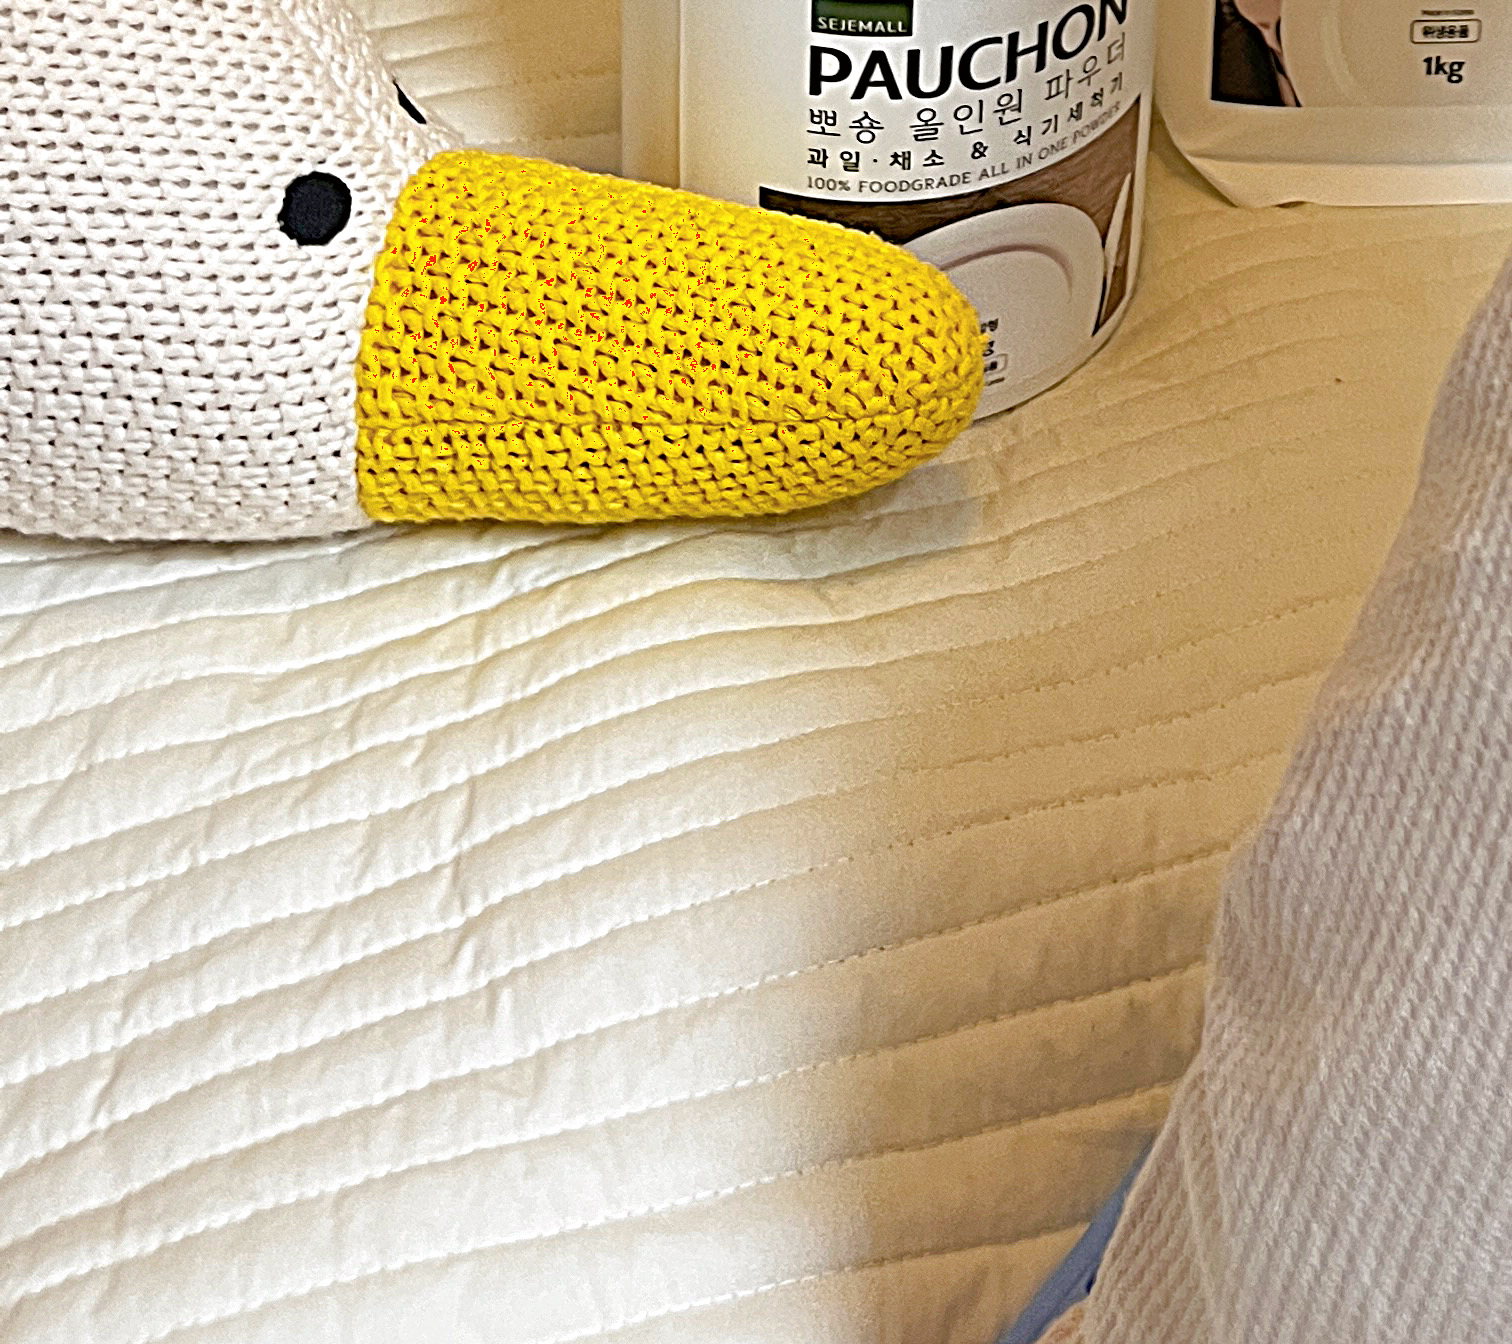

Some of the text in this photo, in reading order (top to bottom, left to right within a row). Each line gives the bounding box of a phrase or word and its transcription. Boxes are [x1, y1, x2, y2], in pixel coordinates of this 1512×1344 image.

[817, 15, 908, 34] SEJEMALL
[1422, 55, 1466, 84] 1kg
[806, 31, 1126, 144] 뽀숑 올인원 파우더
[807, 175, 851, 192] 100%
[858, 171, 972, 193] FOODGRADE
[978, 162, 1010, 182] ALL
[1016, 153, 1033, 170] IN
[1038, 136, 1068, 160] ONE
[970, 141, 989, 160] &
